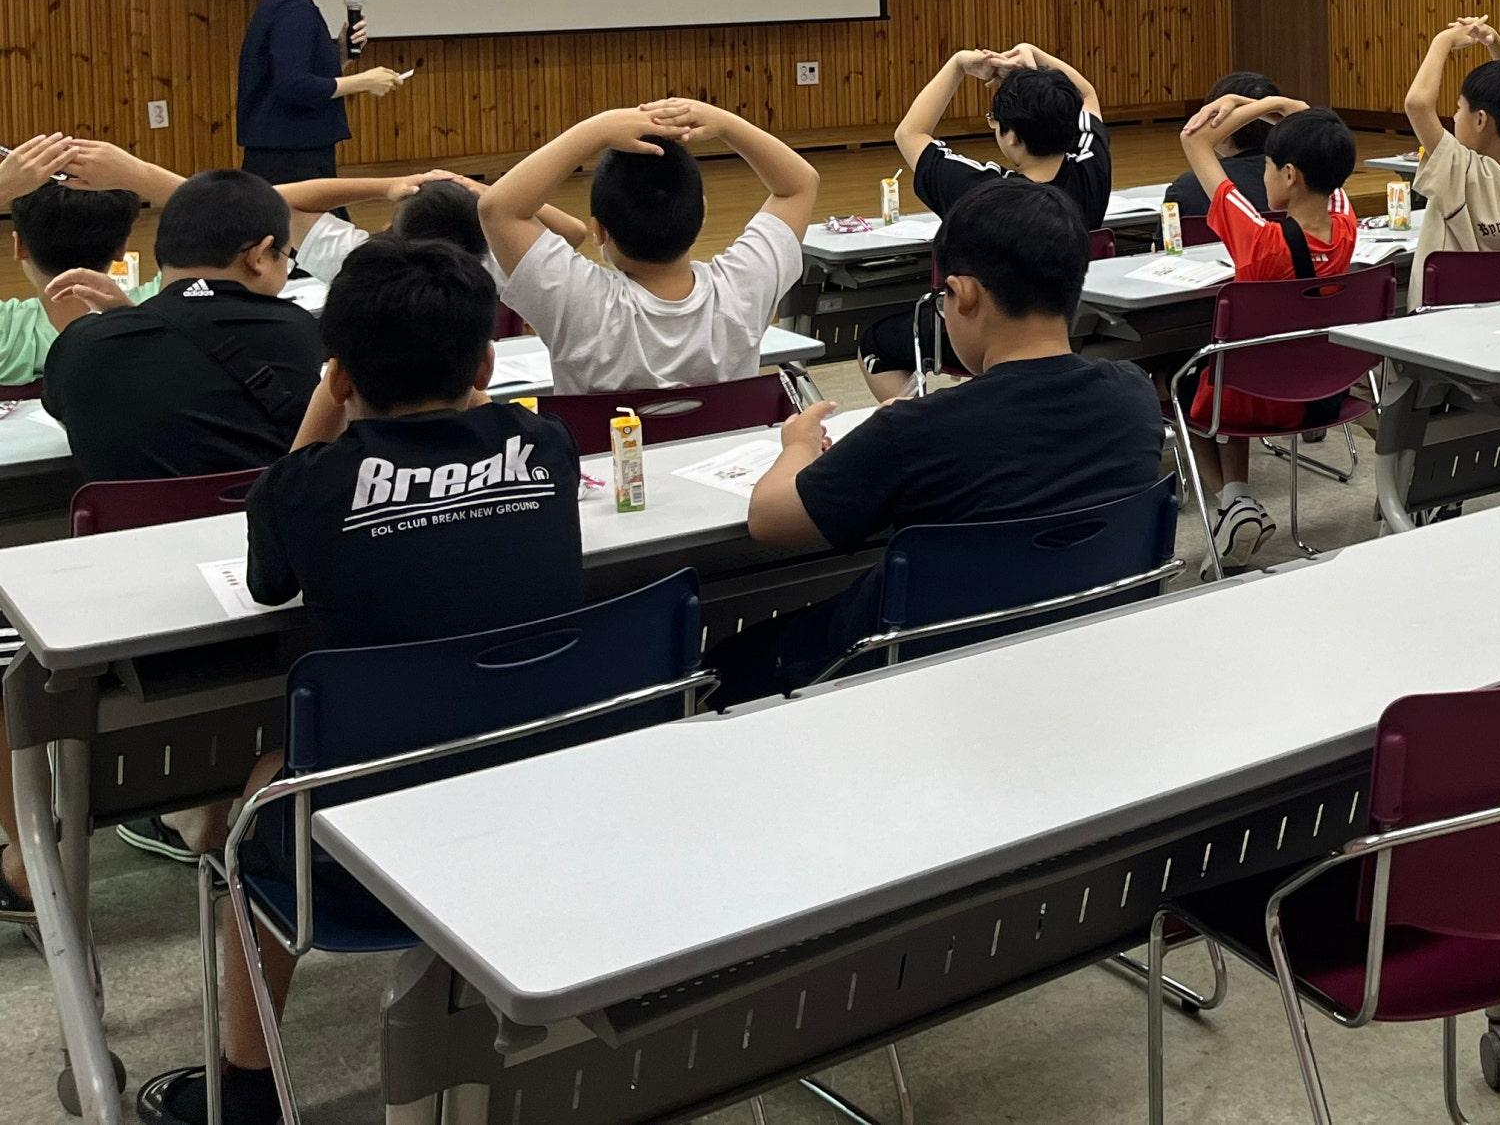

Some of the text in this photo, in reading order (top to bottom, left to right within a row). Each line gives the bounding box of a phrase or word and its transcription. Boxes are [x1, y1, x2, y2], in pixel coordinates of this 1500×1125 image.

[352, 435, 534, 511] Break
[371, 501, 540, 537] EOL CLUB BREAK NEW GROUND
